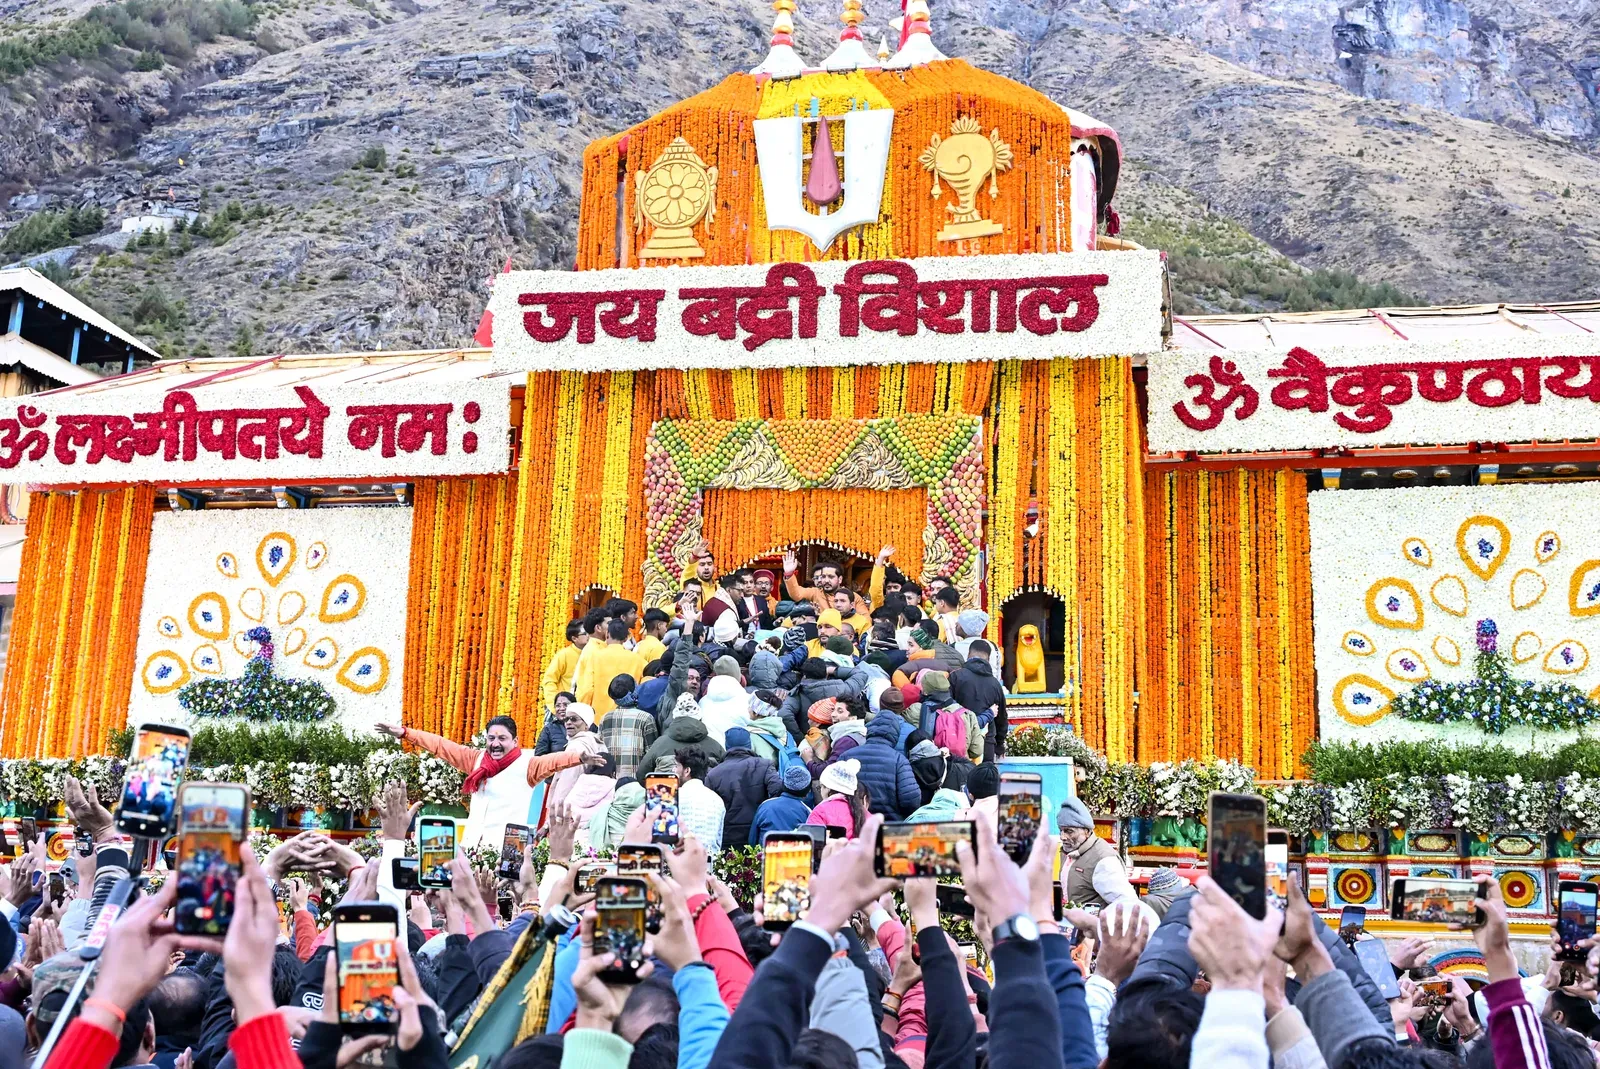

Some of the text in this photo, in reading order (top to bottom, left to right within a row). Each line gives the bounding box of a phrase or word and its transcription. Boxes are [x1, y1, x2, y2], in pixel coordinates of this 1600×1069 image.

[518, 260, 1109, 351] जय बद्री विशाल
[0, 405, 50, 469] ॐ
[54, 386, 330, 464] लक्ष्मीपतये
[1172, 346, 1600, 433] ॐ वैकुण्ठाय
